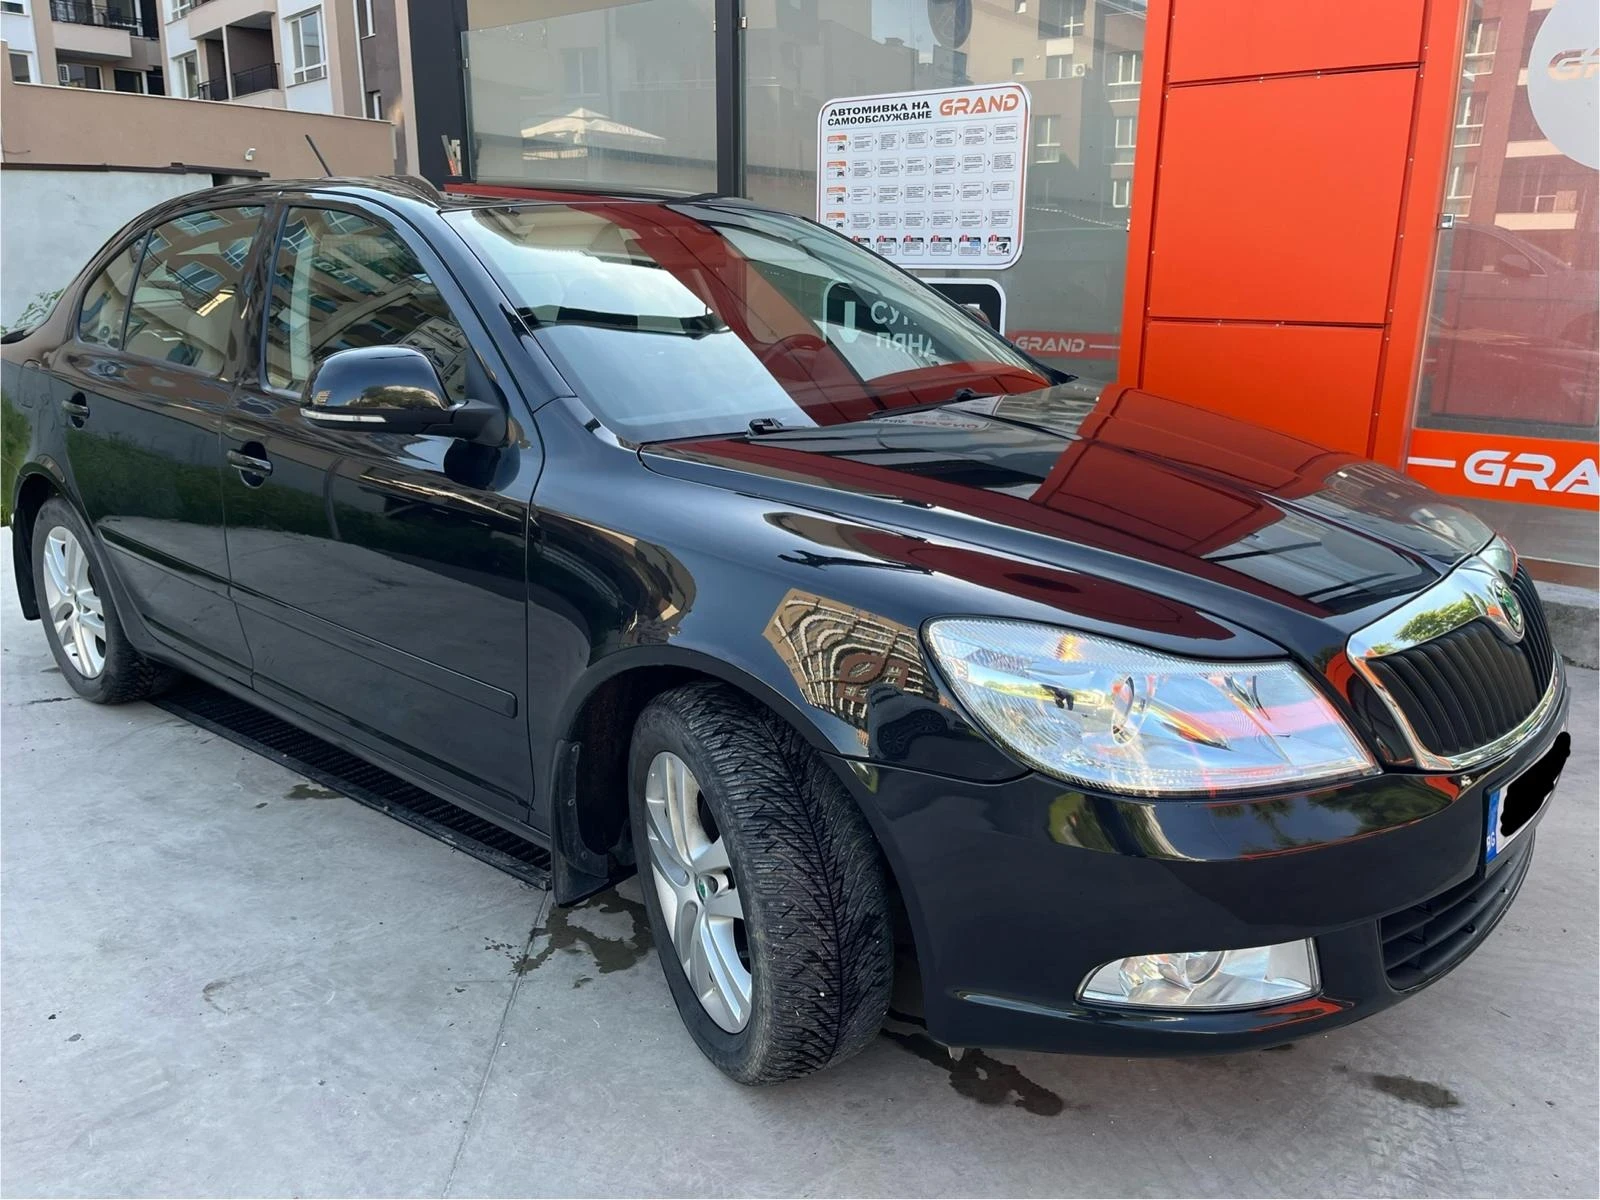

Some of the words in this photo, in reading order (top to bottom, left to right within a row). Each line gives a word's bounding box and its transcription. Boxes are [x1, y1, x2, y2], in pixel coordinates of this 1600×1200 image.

[830, 103, 908, 117] АВТОМИВКА
[912, 101, 930, 111] НА
[939, 94, 1019, 116] GRAND
[828, 111, 932, 126] САМООБСЛУЖВАНЕ
[1015, 336, 1086, 353] GRAND
[1463, 449, 1599, 497] GRA
